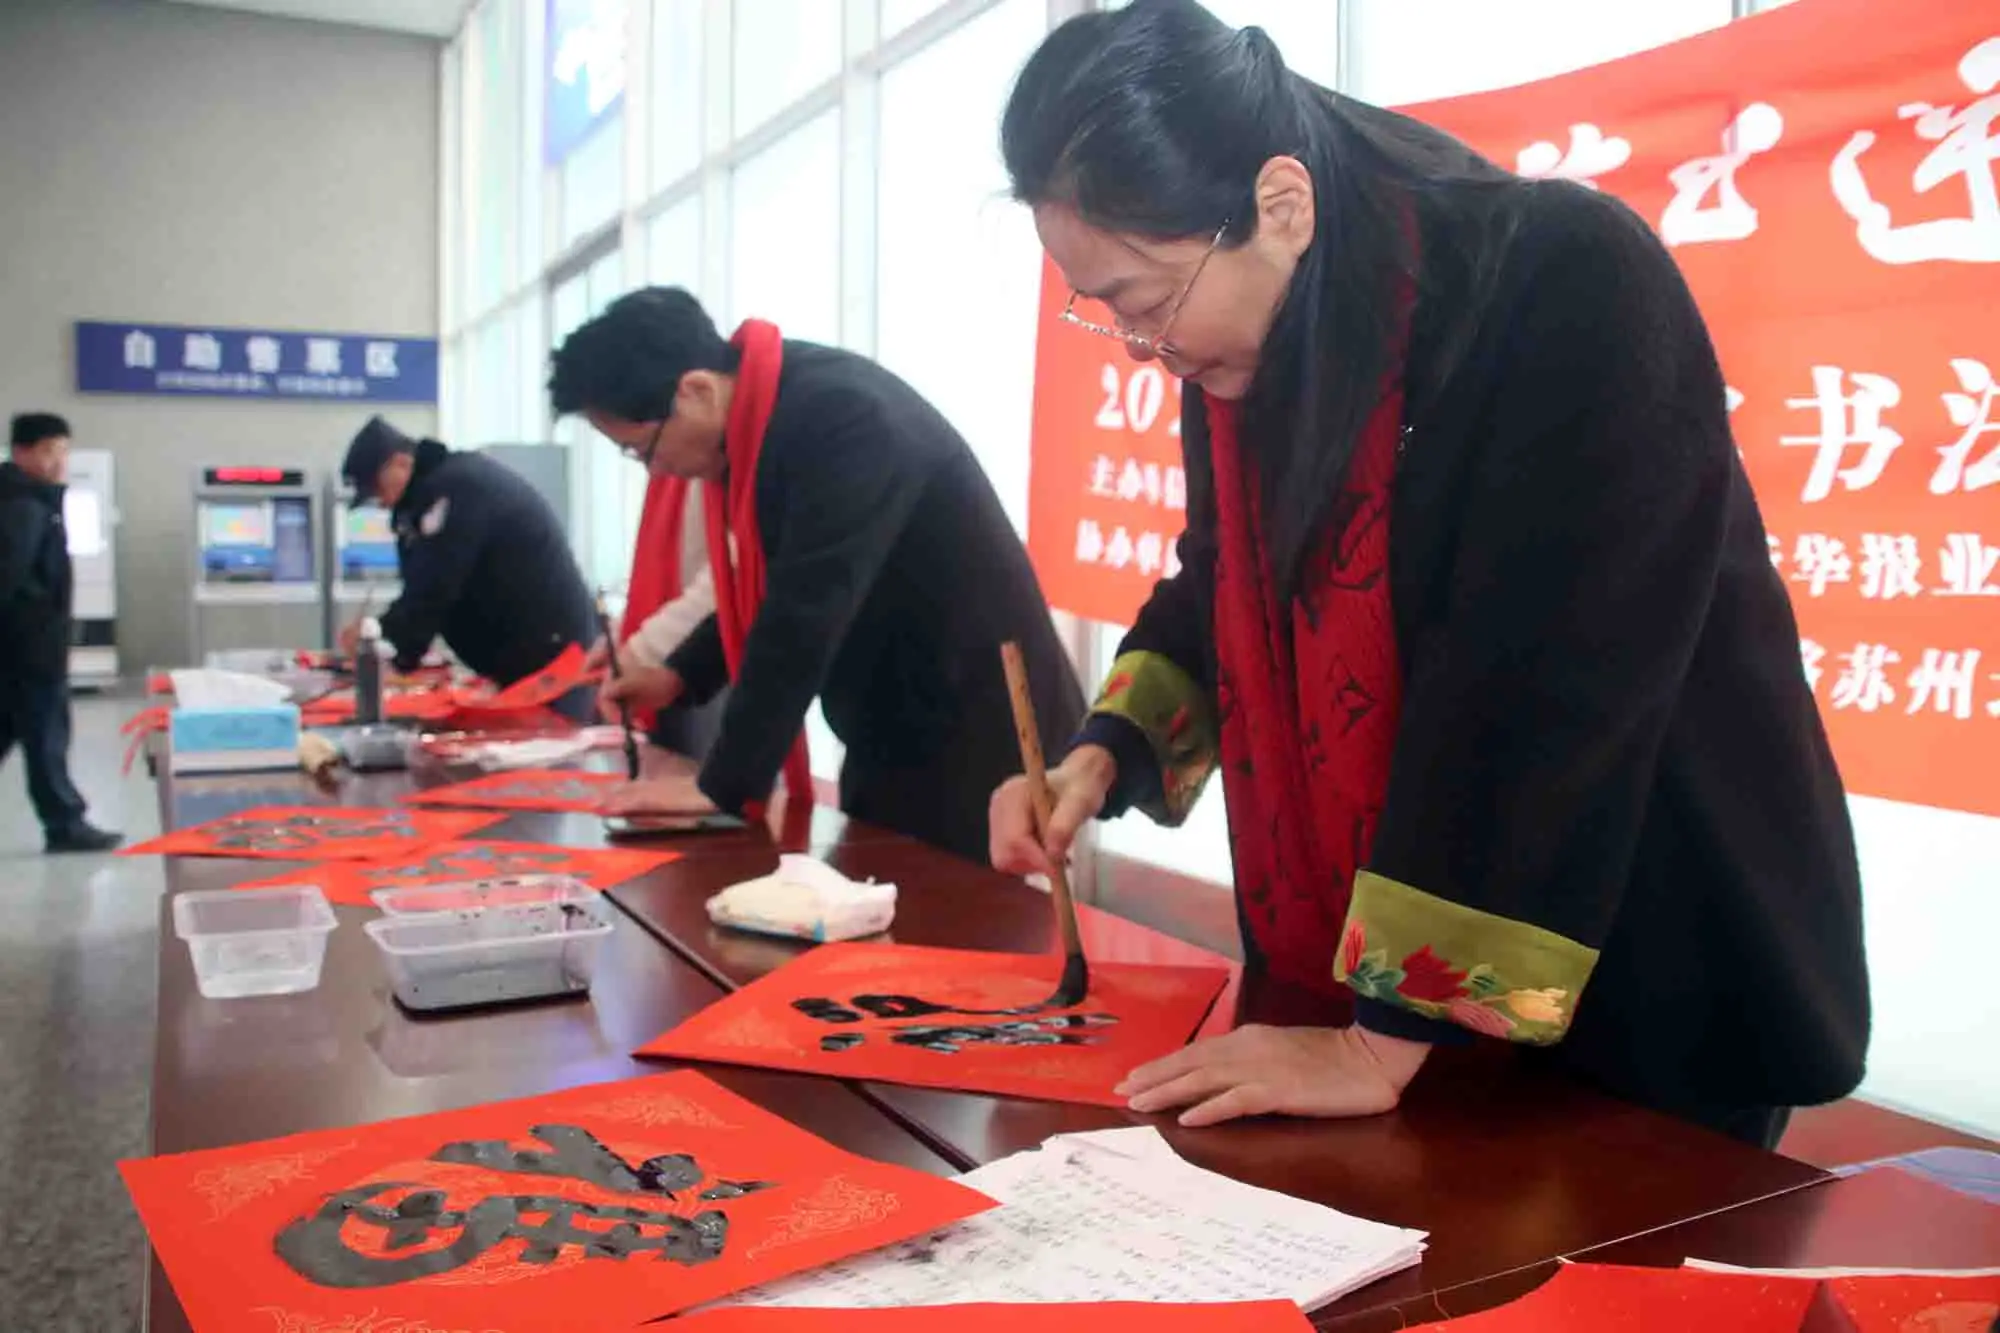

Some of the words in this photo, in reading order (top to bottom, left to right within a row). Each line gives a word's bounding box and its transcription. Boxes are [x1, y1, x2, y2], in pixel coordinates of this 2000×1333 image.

[1726, 358, 2000, 503] 书法
[1766, 532, 2000, 599] 华报业
[1800, 639, 2000, 719] 苏州
